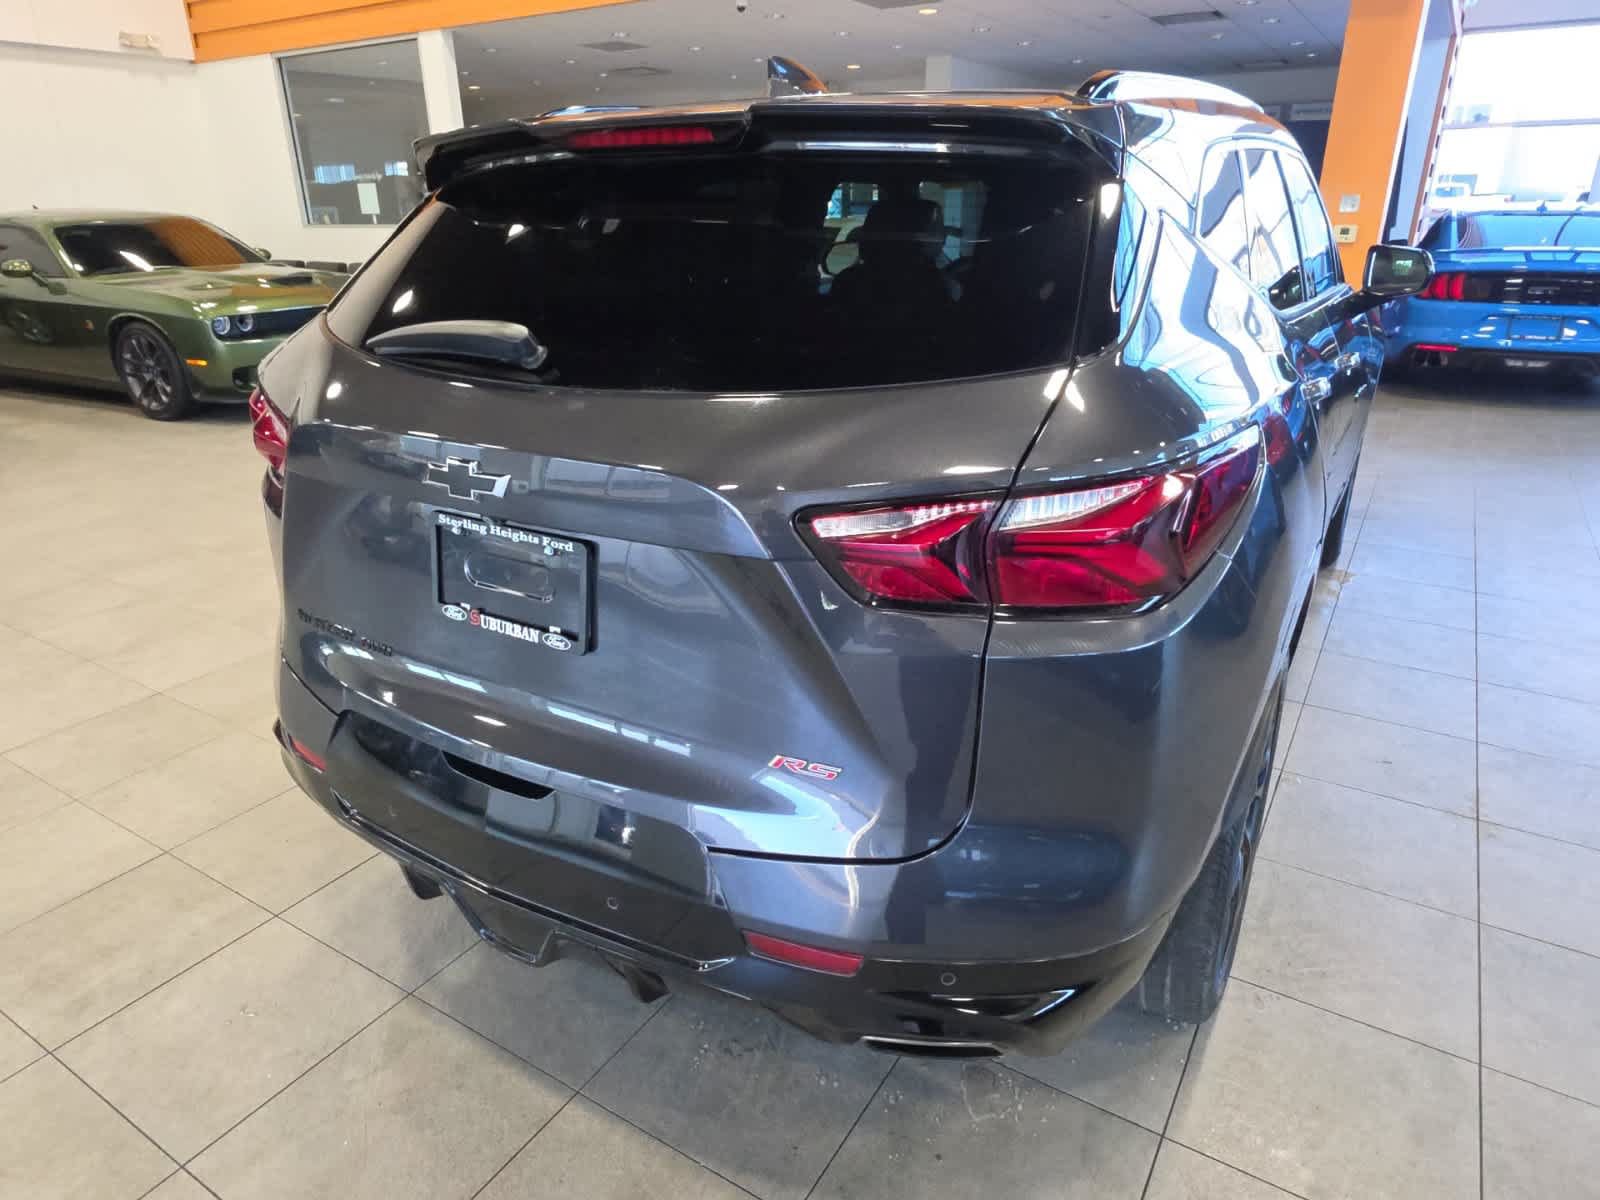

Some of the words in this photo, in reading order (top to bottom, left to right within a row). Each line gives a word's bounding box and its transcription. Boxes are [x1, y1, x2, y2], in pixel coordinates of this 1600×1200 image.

[438, 513, 488, 535] Sterling
[490, 524, 540, 543] Heights
[542, 535, 575, 552] Ford
[469, 608, 541, 643] SUBURBAN
[768, 754, 842, 780] RS
